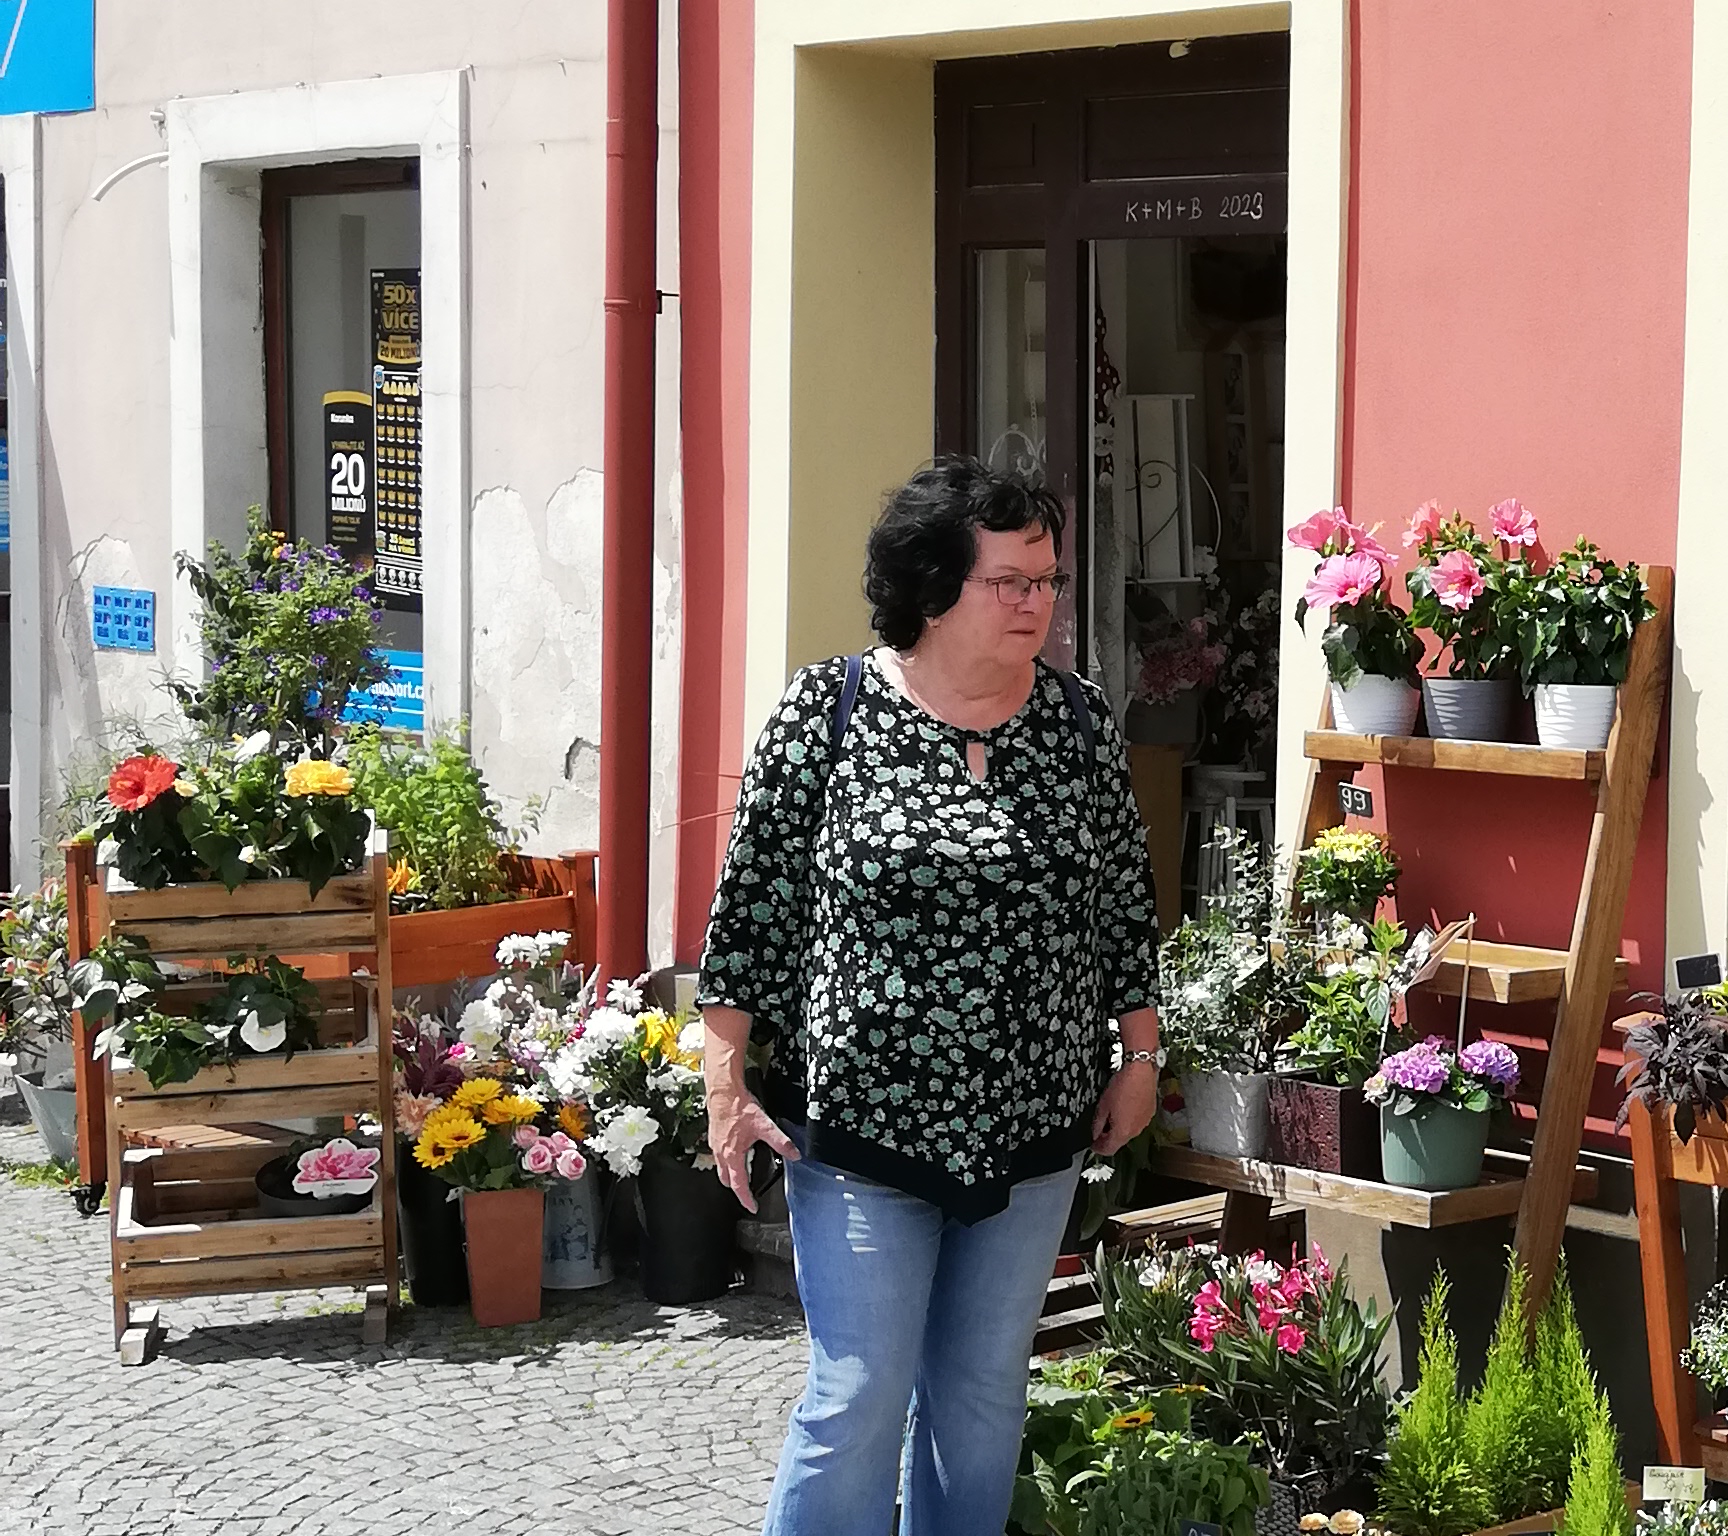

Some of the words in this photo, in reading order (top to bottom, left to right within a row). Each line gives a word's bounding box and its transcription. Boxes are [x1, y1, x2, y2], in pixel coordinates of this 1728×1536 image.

[1219, 192, 1263, 220] 2023
[383, 283, 417, 305] 50x
[382, 308, 419, 330] VÍCE
[331, 452, 366, 496] 20
[1341, 787, 1366, 811] 99
